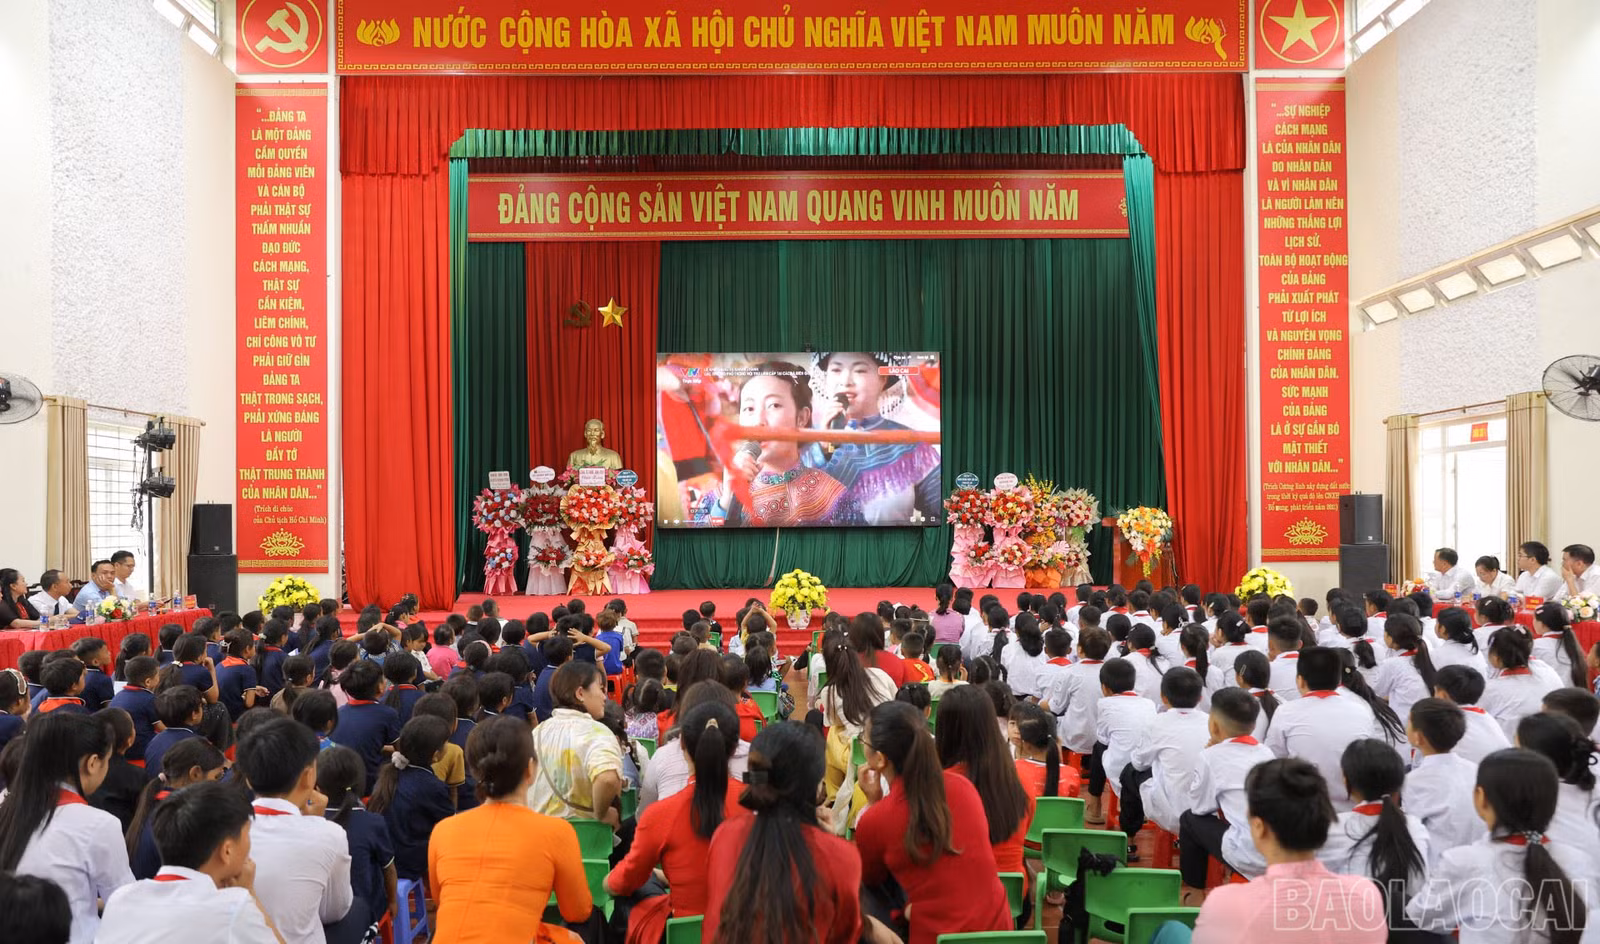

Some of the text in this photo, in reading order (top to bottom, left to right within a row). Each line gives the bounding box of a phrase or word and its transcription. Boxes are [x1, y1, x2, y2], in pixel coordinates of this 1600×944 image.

[413, 4, 1175, 54] NƯỚC CỘNG HÒA XÃ HỘI CHỦ NGHĨA VIỆT NAM MUÔN NĂM
[296, 111, 306, 122] TA
[1298, 103, 1331, 119] NGHIỆP
[251, 126, 311, 143] LÀ MỘT ĐẢNG
[1275, 122, 1328, 137] CÁCH MẠNG
[1262, 139, 1341, 154] LÀ CỦA NHÂN DÂN
[248, 163, 315, 178] MỖI ĐẢNG VIÊN
[1272, 159, 1332, 172] DO NHÂN DÂN
[258, 183, 305, 199] VÀ CÁN BỘ
[1268, 177, 1338, 191] VÀ VÌ NHÂN DÂN
[250, 201, 311, 218] PHẢI THẬT SỰ
[498, 182, 1079, 230] ĐẢNG CỘNG SẢN VIỆT NAM QUANG VINH MUÔN NĂM
[1262, 196, 1344, 210] LÀ NGƯỜI LÀM NÊN
[252, 219, 277, 234] THẤM
[1264, 213, 1342, 231] NHỮNG THẮNG LỢI
[262, 240, 301, 256] ĐẠO ĐỨC
[1285, 236, 1304, 250] LỊCH
[253, 259, 310, 275] CÁCH MẠNG,
[1260, 252, 1348, 269] TOÀN BỘ HOẠT ĐỘNG
[1281, 270, 1326, 285] CỦA ĐẢNG
[262, 278, 300, 294] THẬT SỰ
[1268, 288, 1339, 304] PHẢI XUẤT PHÁT
[279, 296, 305, 312] KIỆM,
[254, 315, 309, 330] LIÊM CHÍNH,
[1282, 309, 1326, 325] TỪ LỢI ÍCH
[246, 334, 316, 348] CHÍ CÔNG VÔ TƯ
[1267, 328, 1342, 344] VÀ NGUYỆN VỌNG
[253, 352, 310, 367] PHẢI GIỮ GÌN
[1278, 347, 1331, 360] CHÍNH ĐÁNG
[263, 370, 300, 385] ĐẢNG TA
[1270, 364, 1339, 379] CỦA NHÂN DÂN.
[240, 391, 323, 407] THẬT TRONG SẠCH,
[1282, 384, 1328, 400] SỨC MẠNH
[244, 408, 319, 423] PHẢI XỨNG ĐÁNG
[1283, 401, 1328, 416] CỦA ĐẢNG
[261, 428, 302, 442] LÀ NGƯỜI
[1270, 420, 1339, 438] LÀ Ở SỰ GẮN BÓ
[286, 447, 298, 461] TỚ
[1283, 439, 1328, 456] MẬT THIẾT
[1268, 460, 1282, 473] VỚI
[1285, 460, 1310, 473] NHÂN
[240, 466, 325, 483] THẬT TRUNG THÀNH
[242, 484, 260, 499] CỦA
[262, 485, 287, 499] NHÂN
